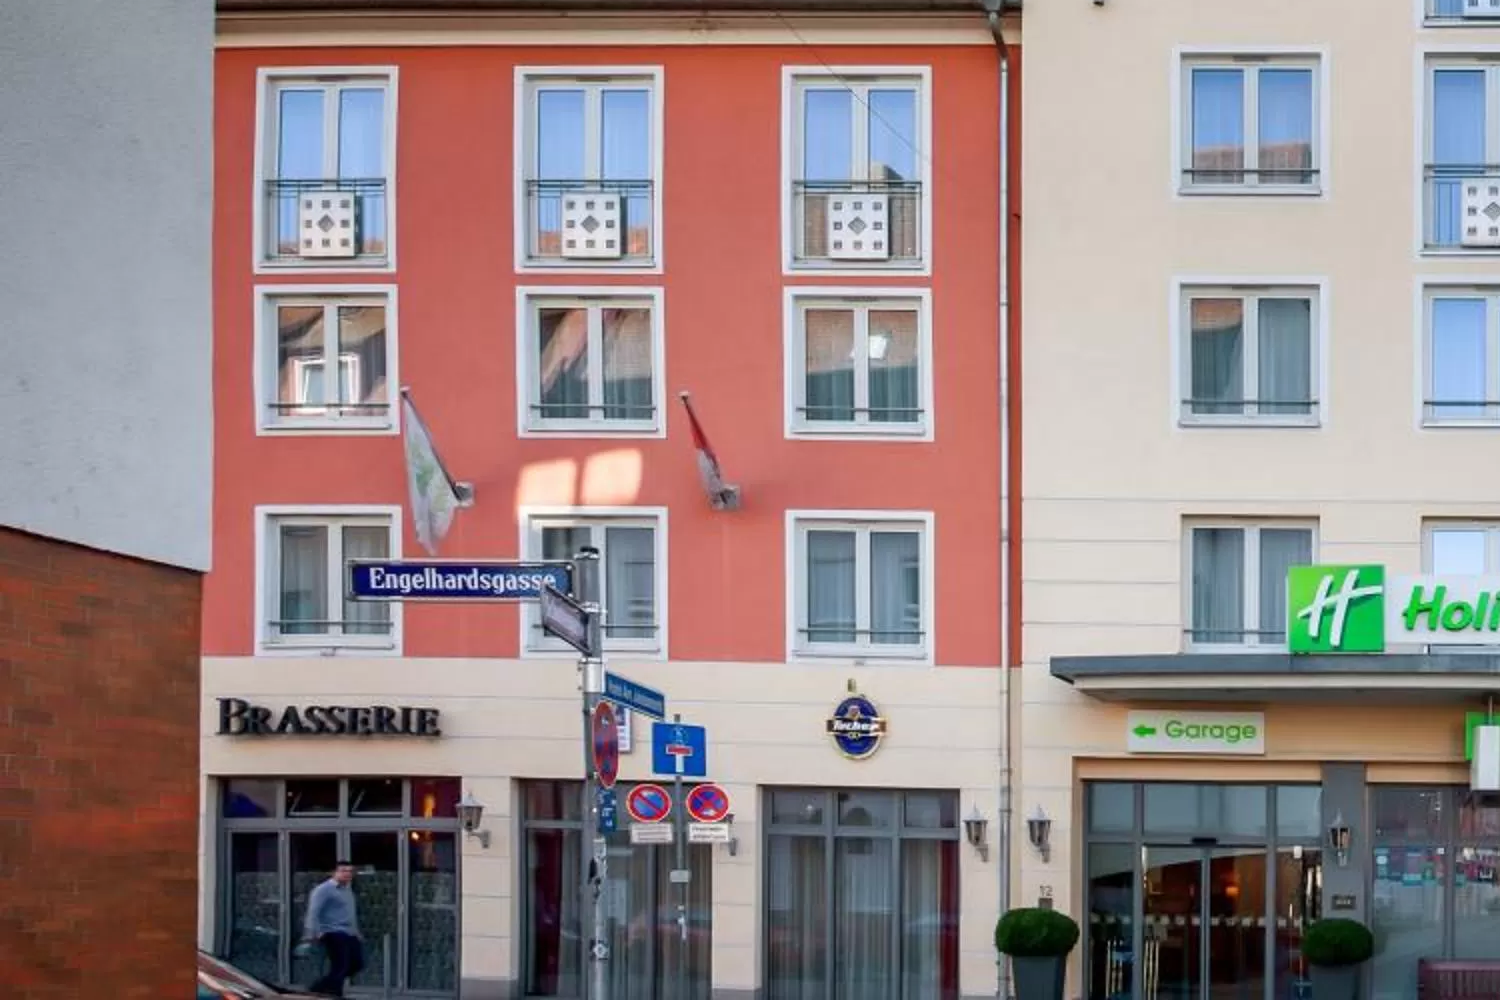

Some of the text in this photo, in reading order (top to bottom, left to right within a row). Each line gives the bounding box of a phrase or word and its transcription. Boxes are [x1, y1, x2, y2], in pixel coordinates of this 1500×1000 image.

[369, 567, 556, 593] Engelhardsgasse
[216, 697, 442, 736] BRASSERIE
[1165, 720, 1257, 743] Garage
